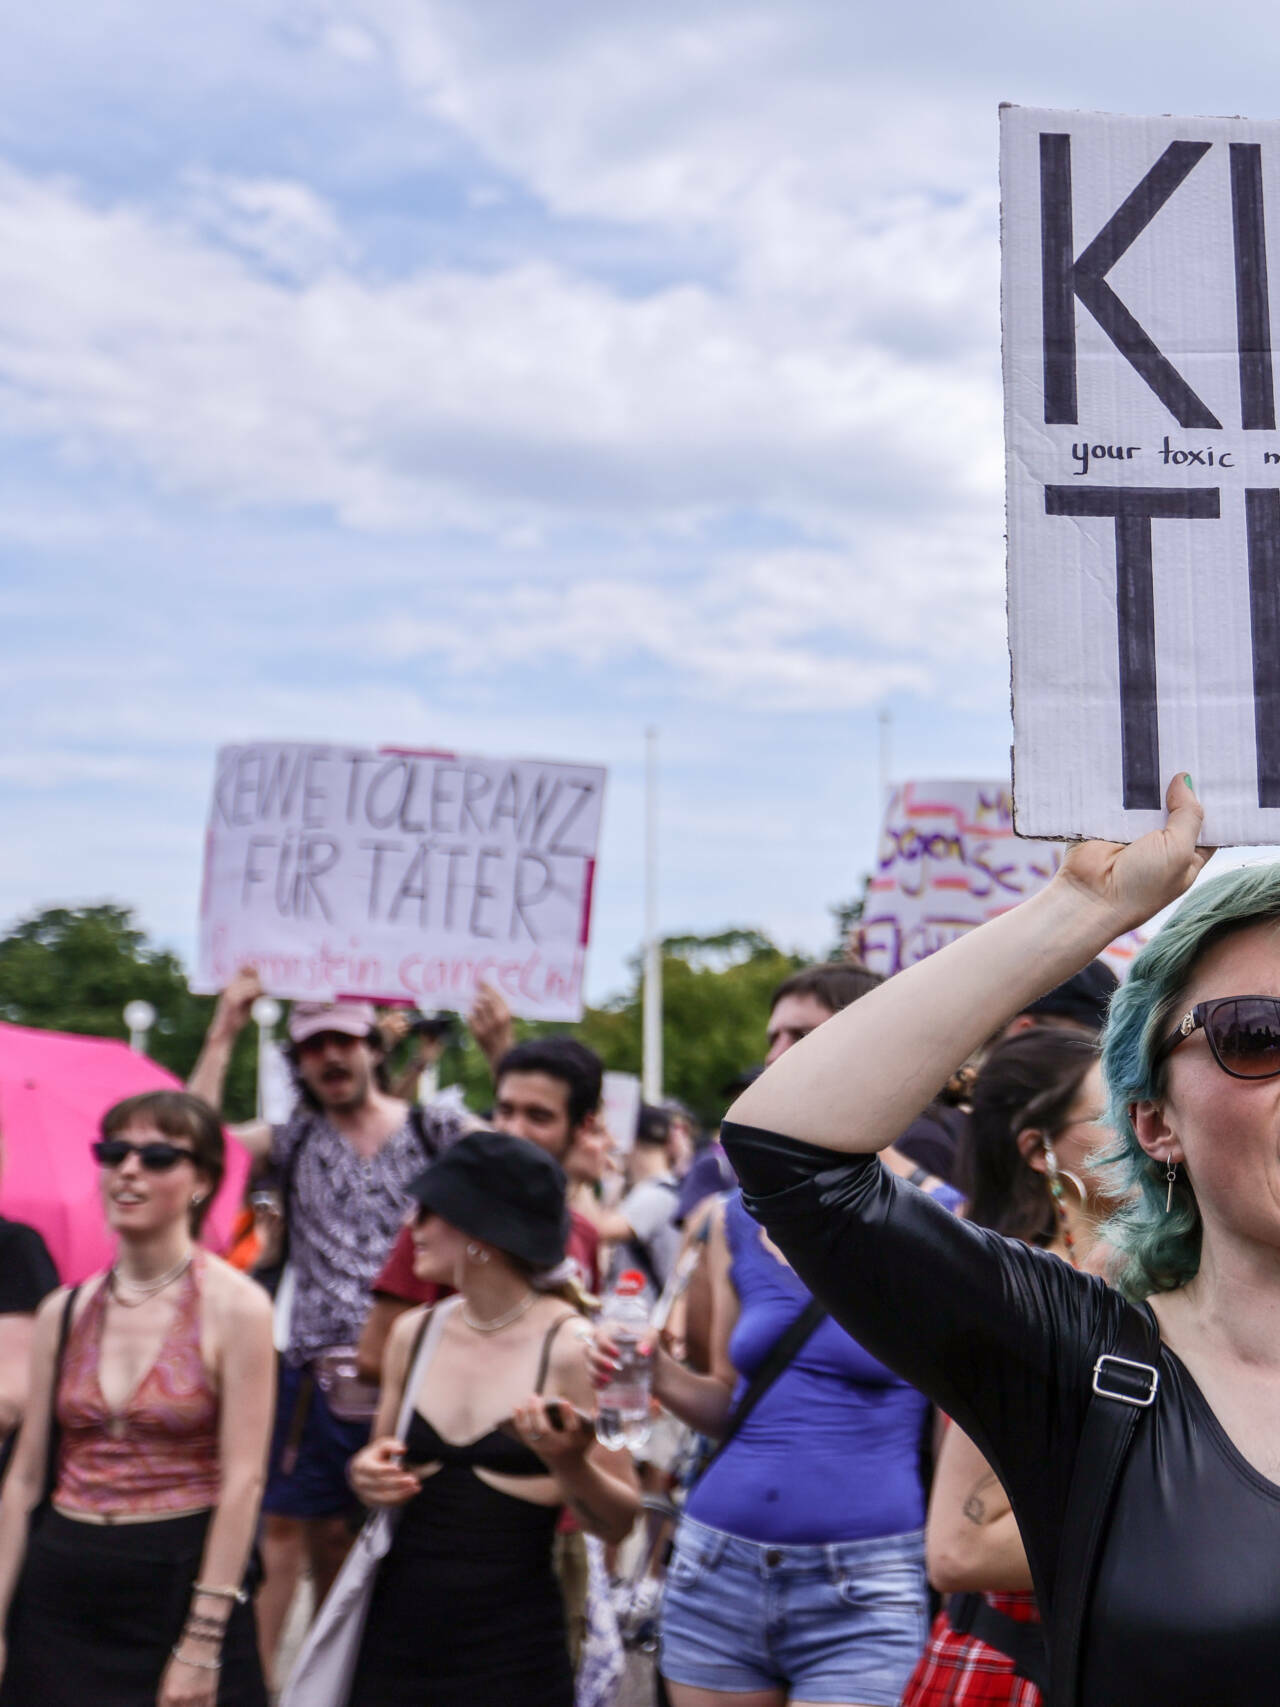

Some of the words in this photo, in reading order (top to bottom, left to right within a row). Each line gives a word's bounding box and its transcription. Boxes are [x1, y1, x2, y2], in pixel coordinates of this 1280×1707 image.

[1071, 441, 1142, 476] your
[1158, 436, 1234, 468] toxic
[343, 754, 596, 856] TOLERANZ
